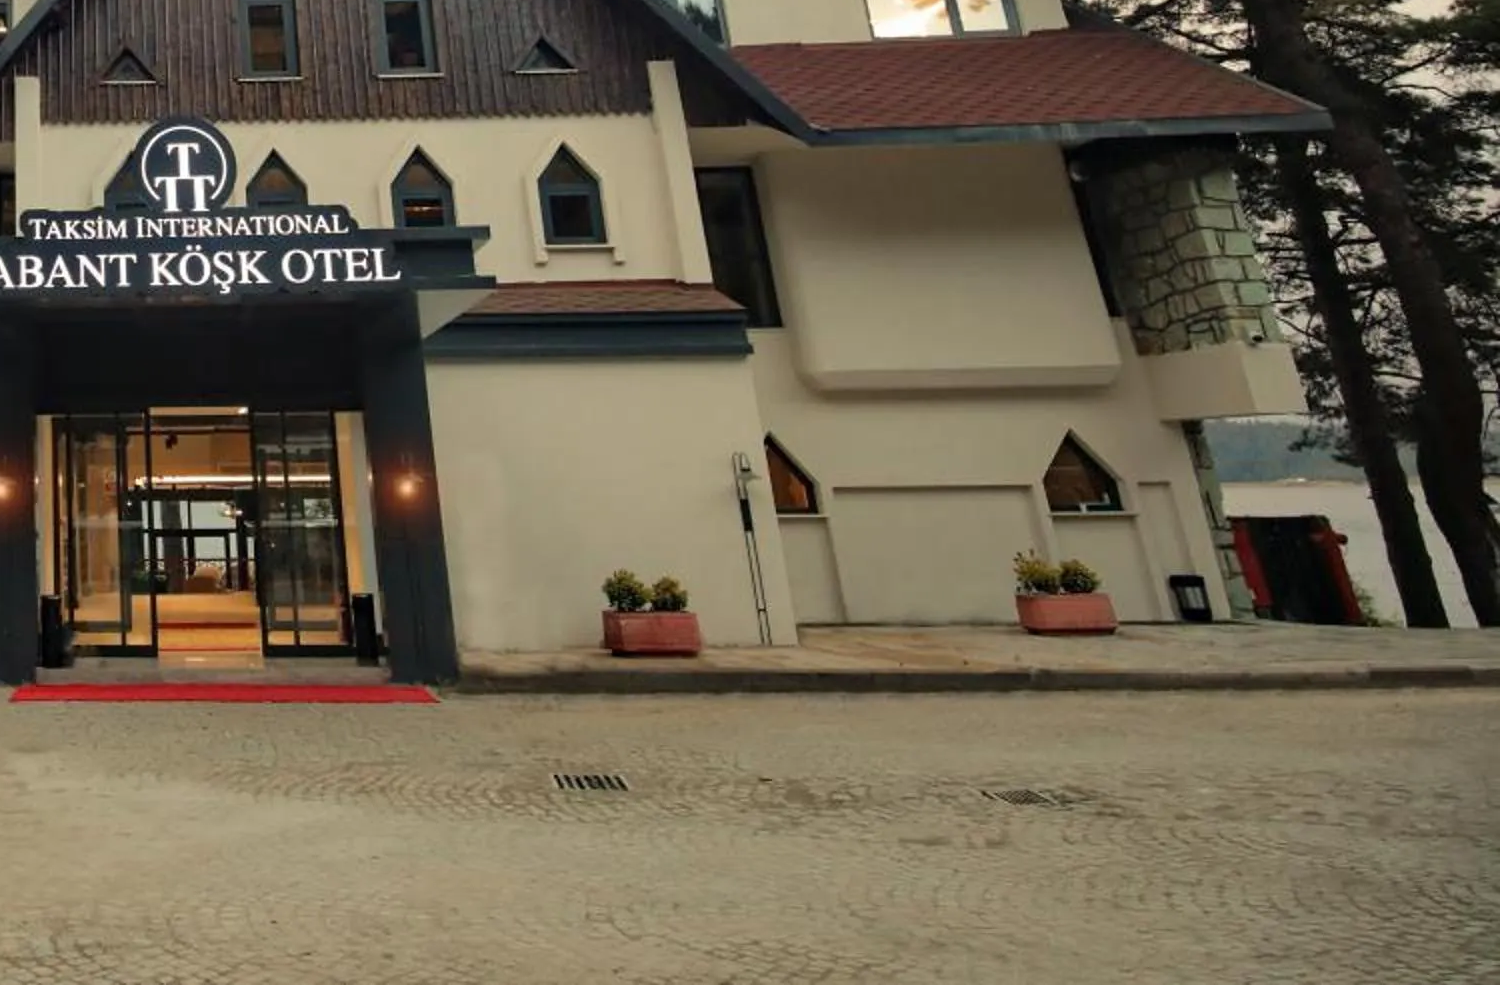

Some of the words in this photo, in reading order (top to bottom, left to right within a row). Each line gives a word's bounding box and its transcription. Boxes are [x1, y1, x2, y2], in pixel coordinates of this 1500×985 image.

[27, 216, 128, 240] TAKSİM
[135, 214, 349, 238] INTERNATIONAL
[149, 244, 272, 294] KÖŞK
[280, 248, 402, 284] OTEL
